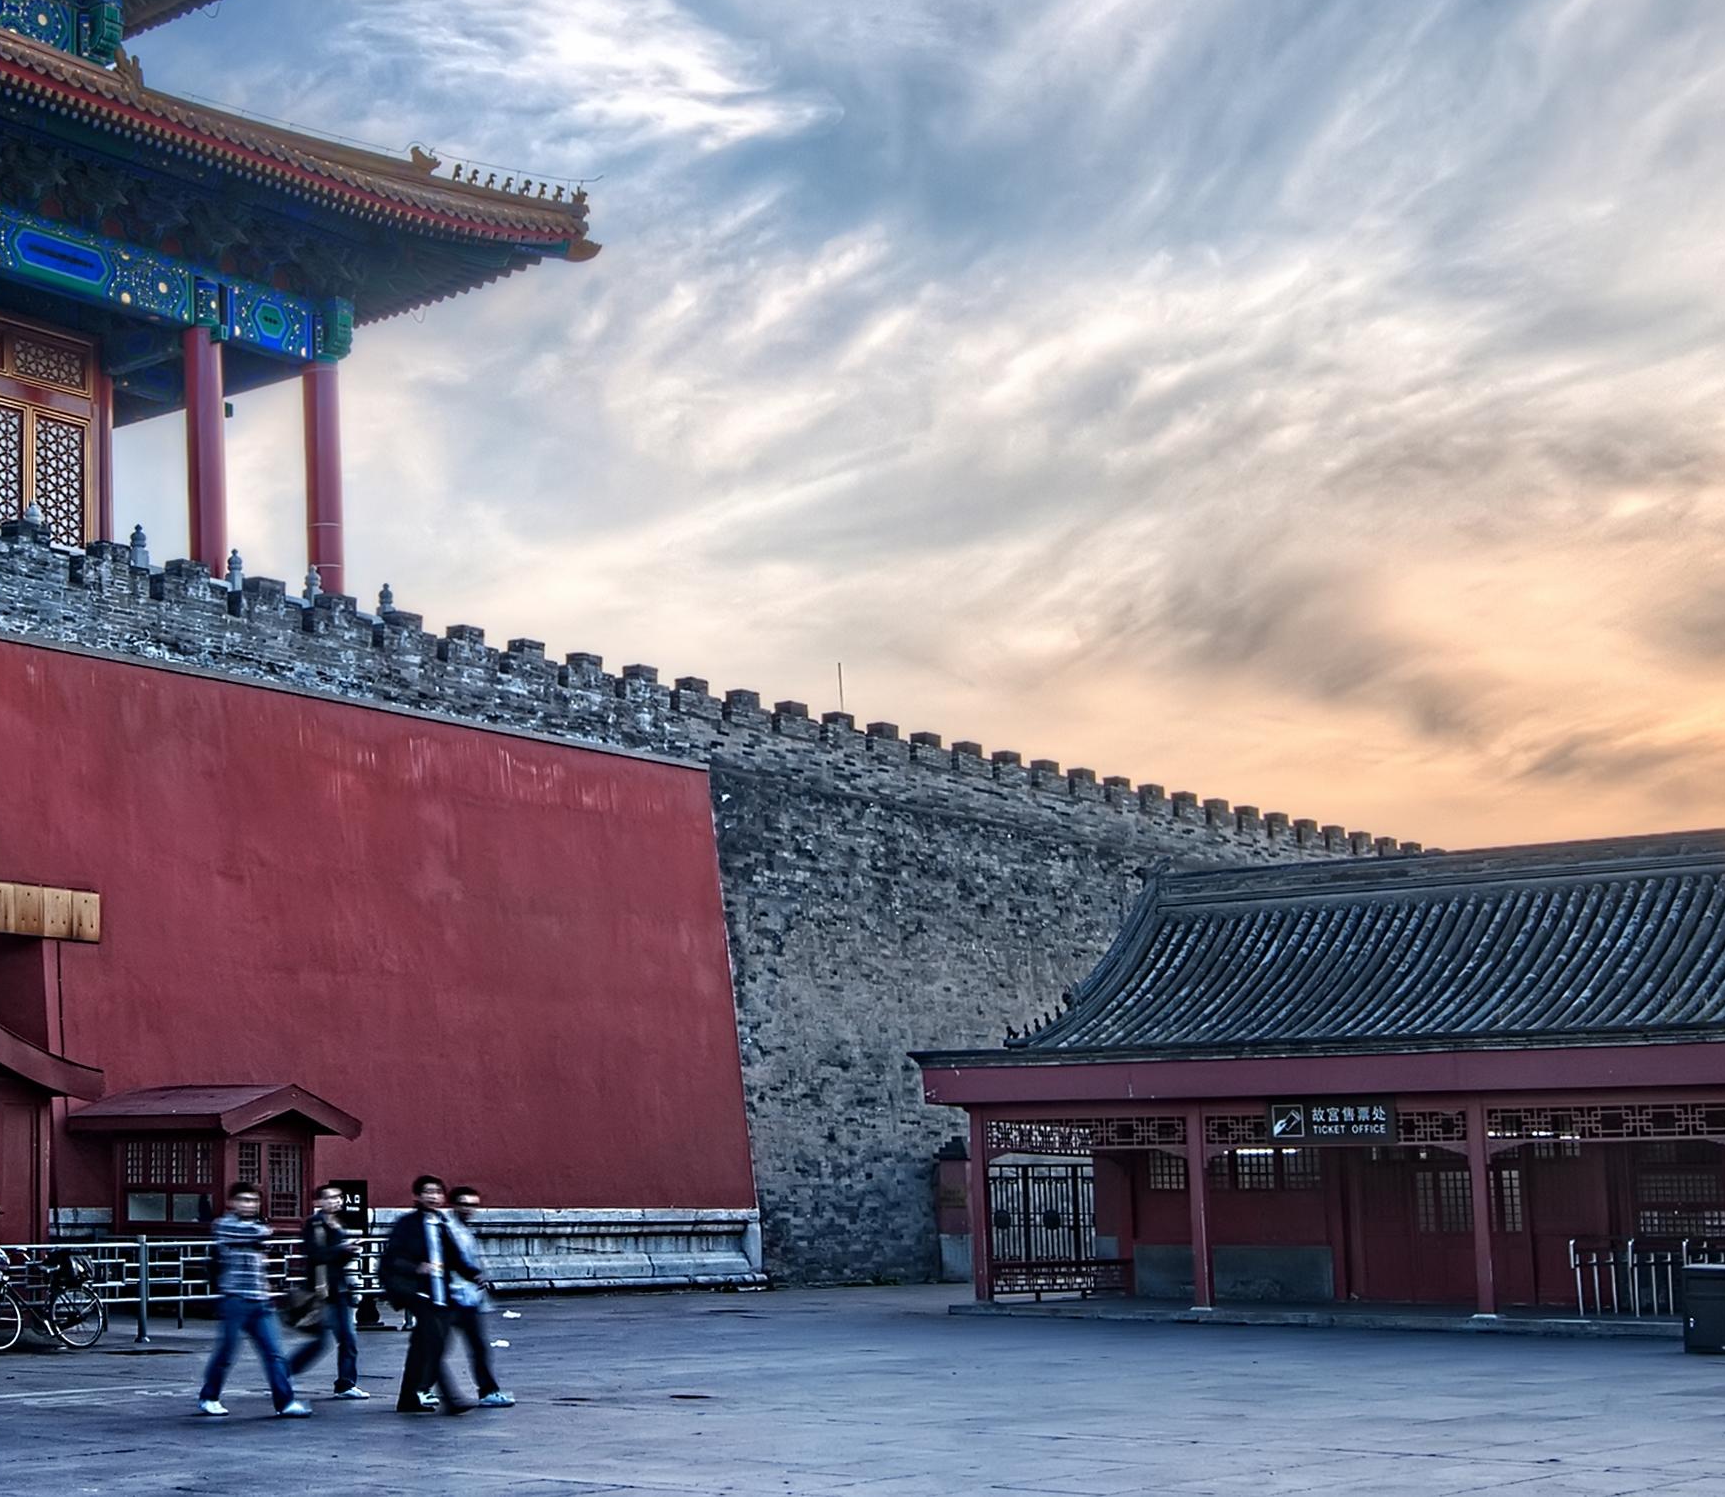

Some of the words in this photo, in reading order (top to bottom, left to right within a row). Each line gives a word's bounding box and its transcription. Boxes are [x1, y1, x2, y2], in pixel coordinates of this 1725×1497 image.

[1312, 1105, 1386, 1122] 故宫售票处
[1313, 1124, 1345, 1135] TICKET
[1351, 1124, 1386, 1135] OFFICE
